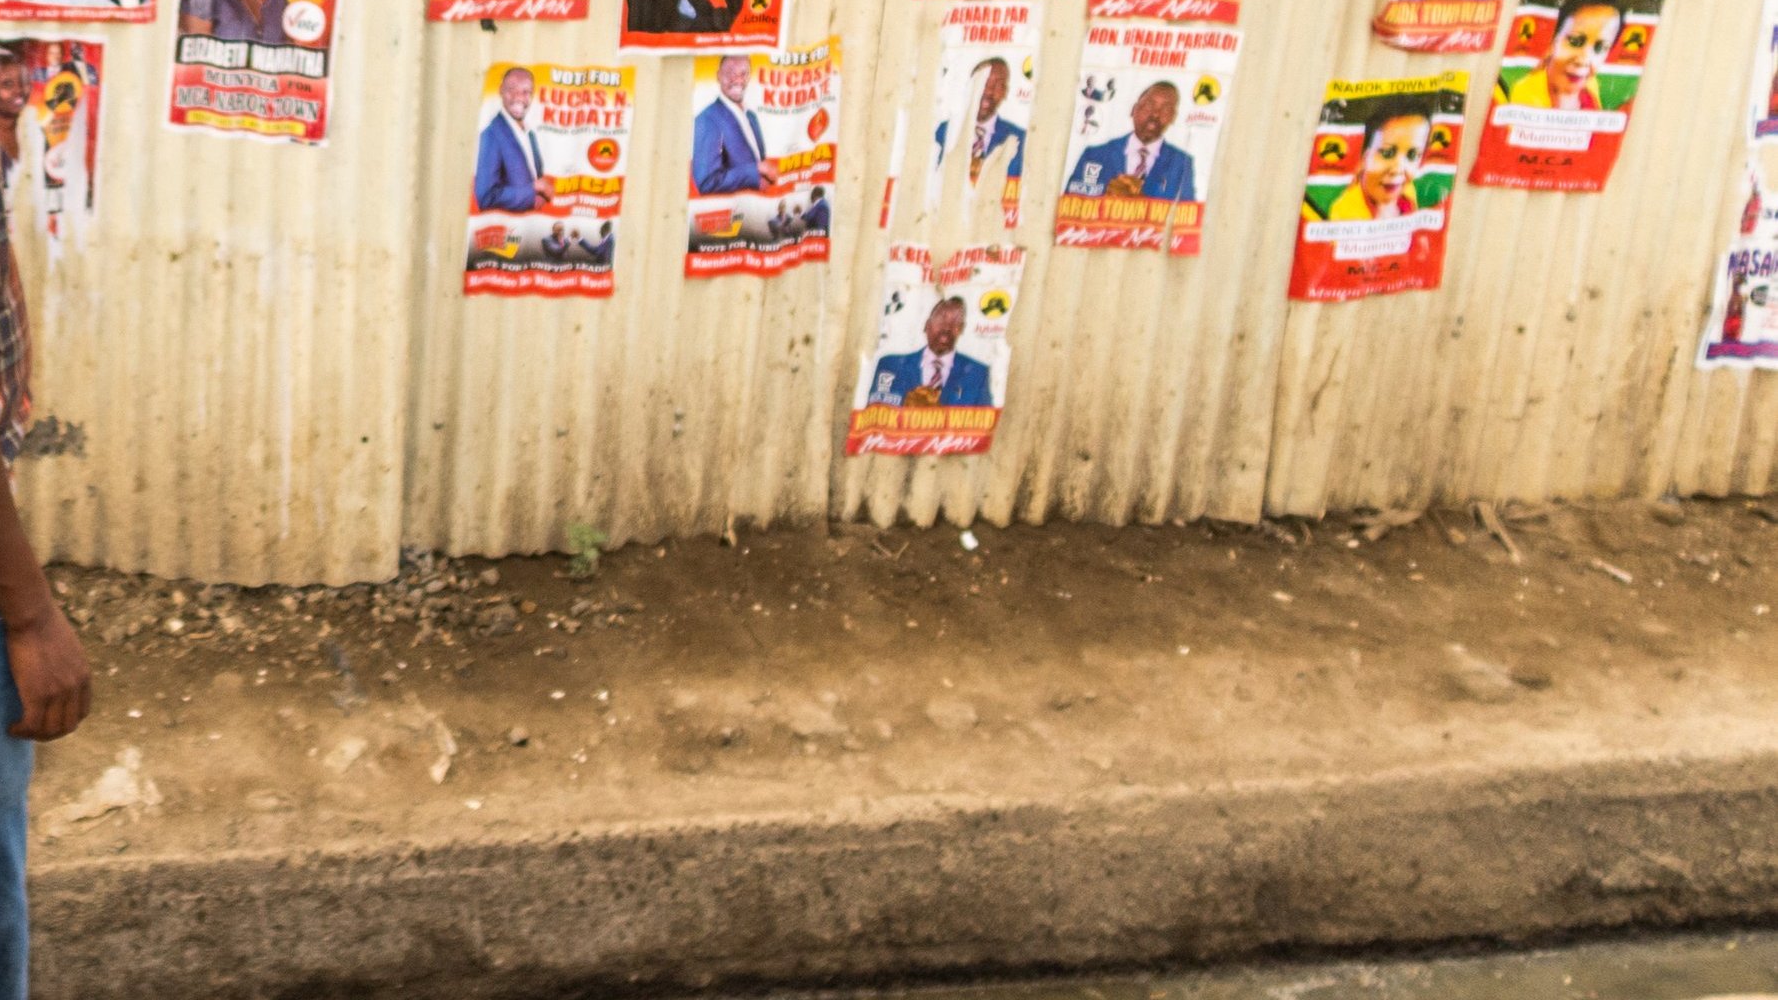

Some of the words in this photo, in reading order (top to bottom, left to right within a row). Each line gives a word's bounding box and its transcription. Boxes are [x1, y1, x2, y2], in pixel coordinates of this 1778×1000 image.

[1132, 49, 1188, 68] TOROME
[590, 70, 621, 86] FOR
[1333, 81, 1384, 94] NAROK
[1389, 80, 1426, 93] TOWN
[539, 87, 603, 106] LUCAS
[555, 176, 621, 194] MCA
